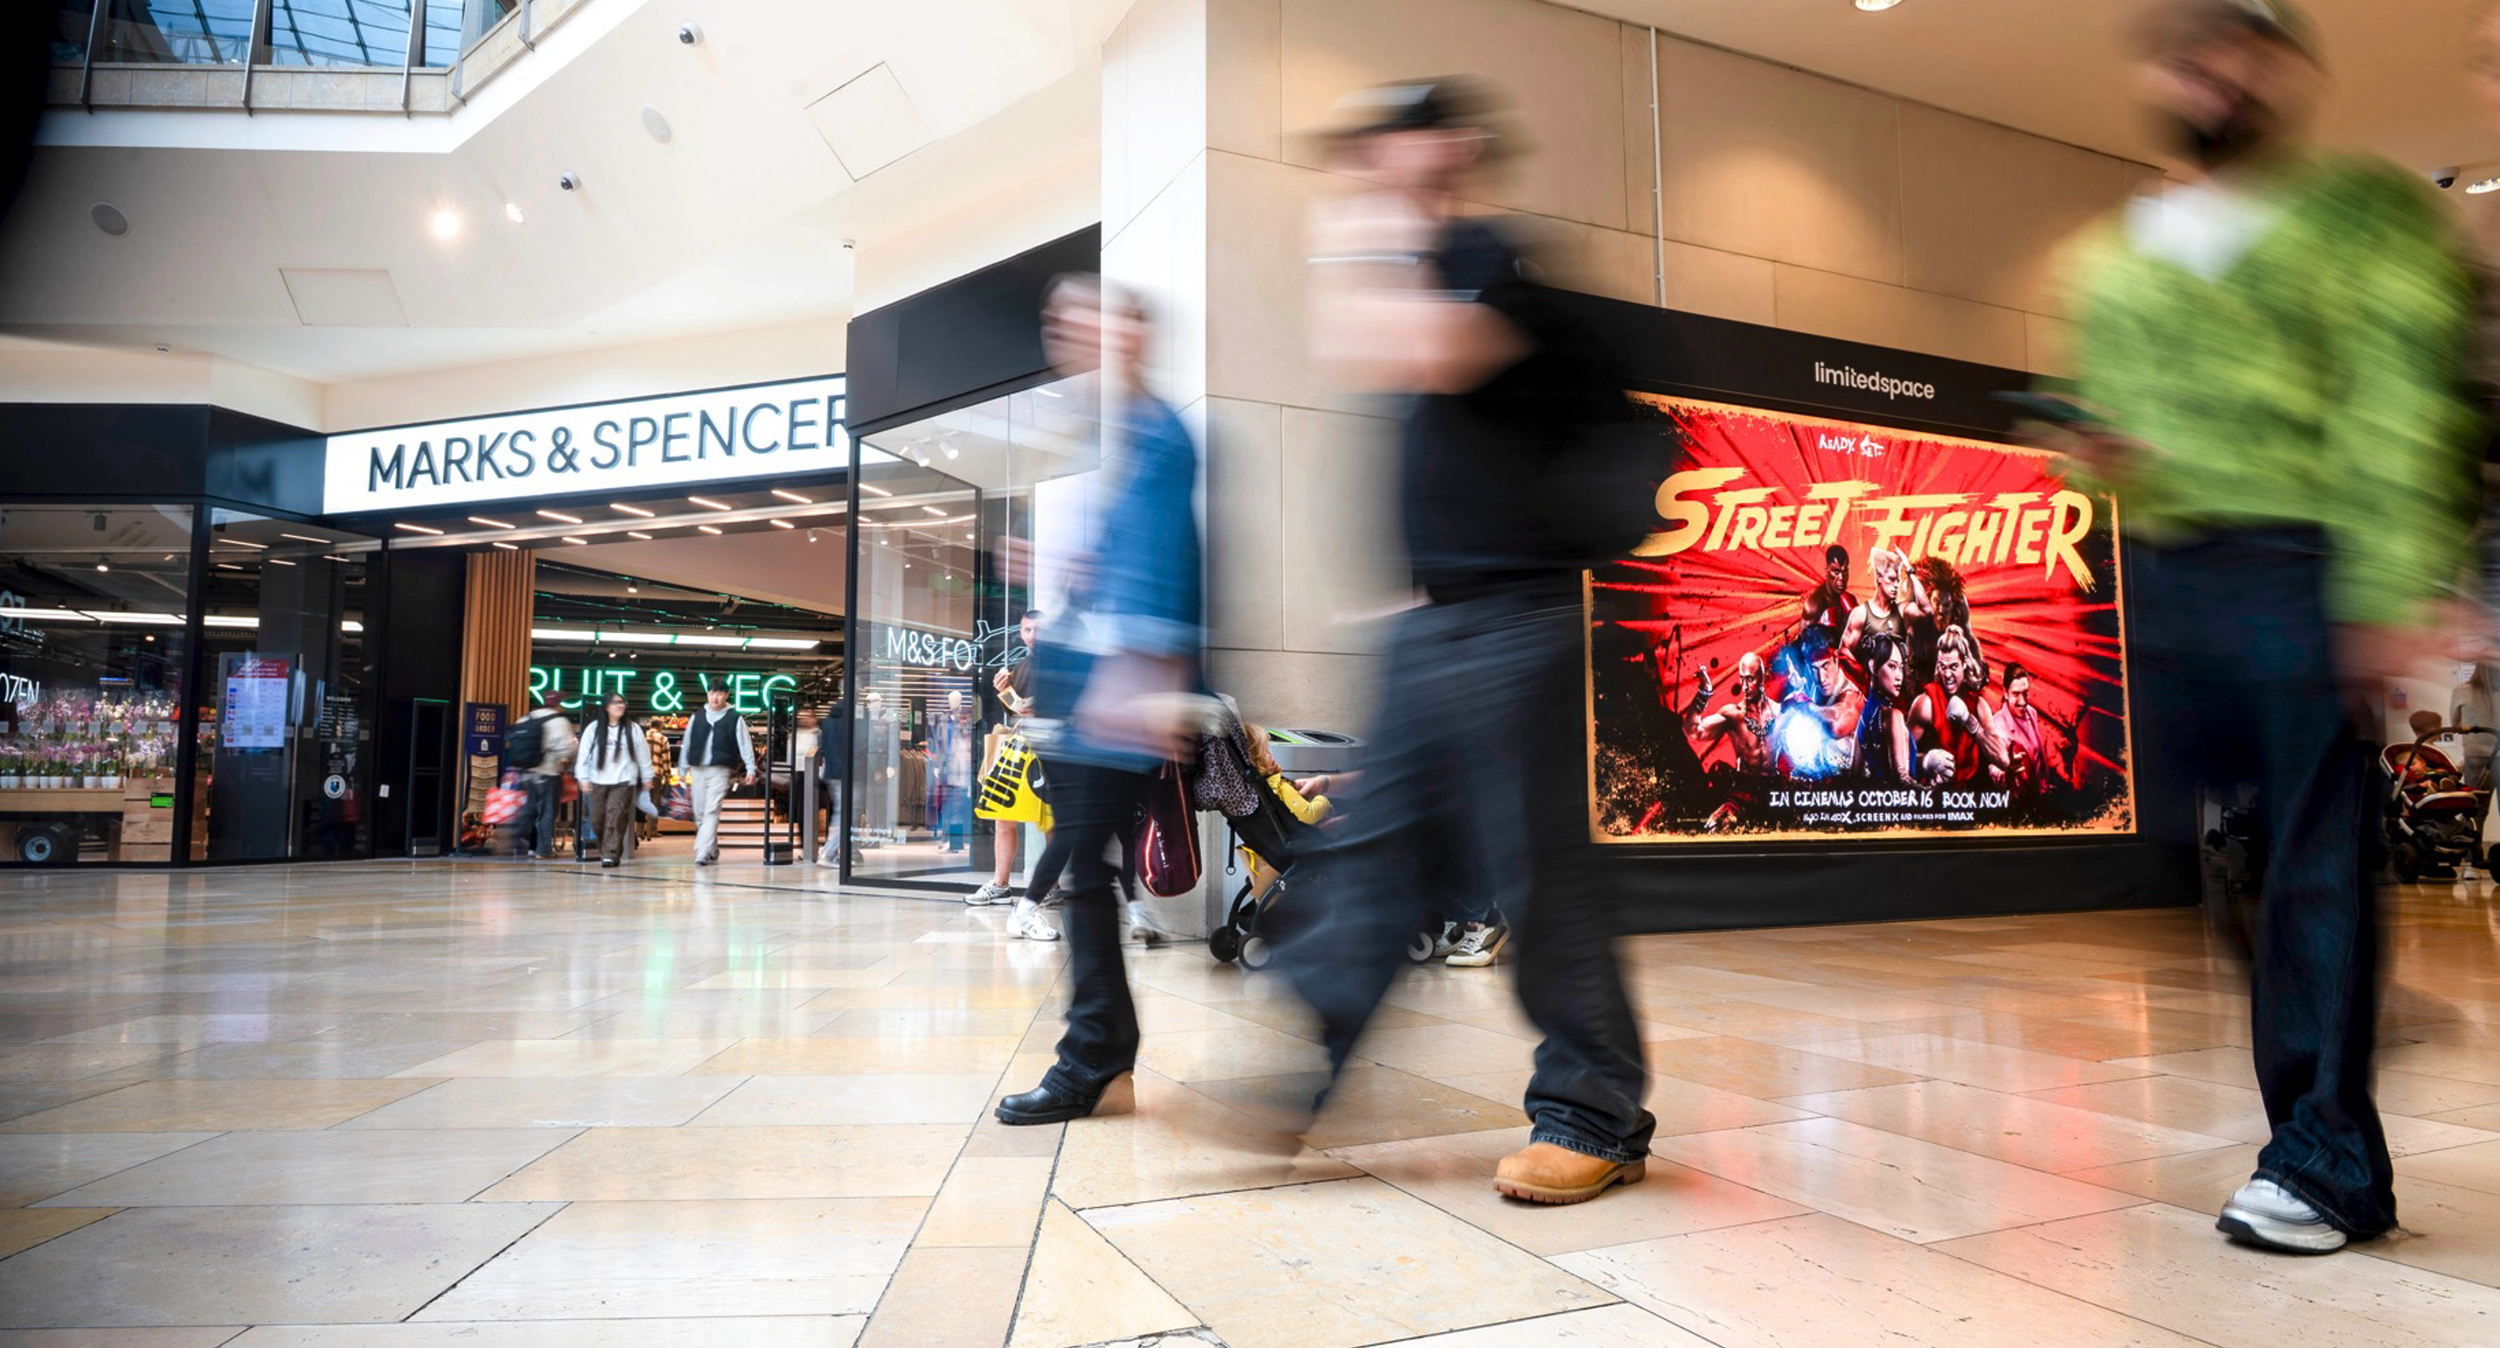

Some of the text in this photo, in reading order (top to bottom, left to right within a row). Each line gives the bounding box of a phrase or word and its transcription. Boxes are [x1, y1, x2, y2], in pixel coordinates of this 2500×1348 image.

[1815, 361, 1935, 400] limitedspace
[368, 430, 537, 492] MARKS
[546, 426, 582, 474] &
[1630, 467, 2097, 594] STREET FIGHTER
[887, 626, 935, 666] M&S
[651, 672, 683, 712] &
[1769, 790, 2010, 809] IN CINEMAS OCTOBER 16 BOOK NOW
[1855, 812, 1899, 823] SCREENX
[1947, 812, 1975, 822] IMAX
